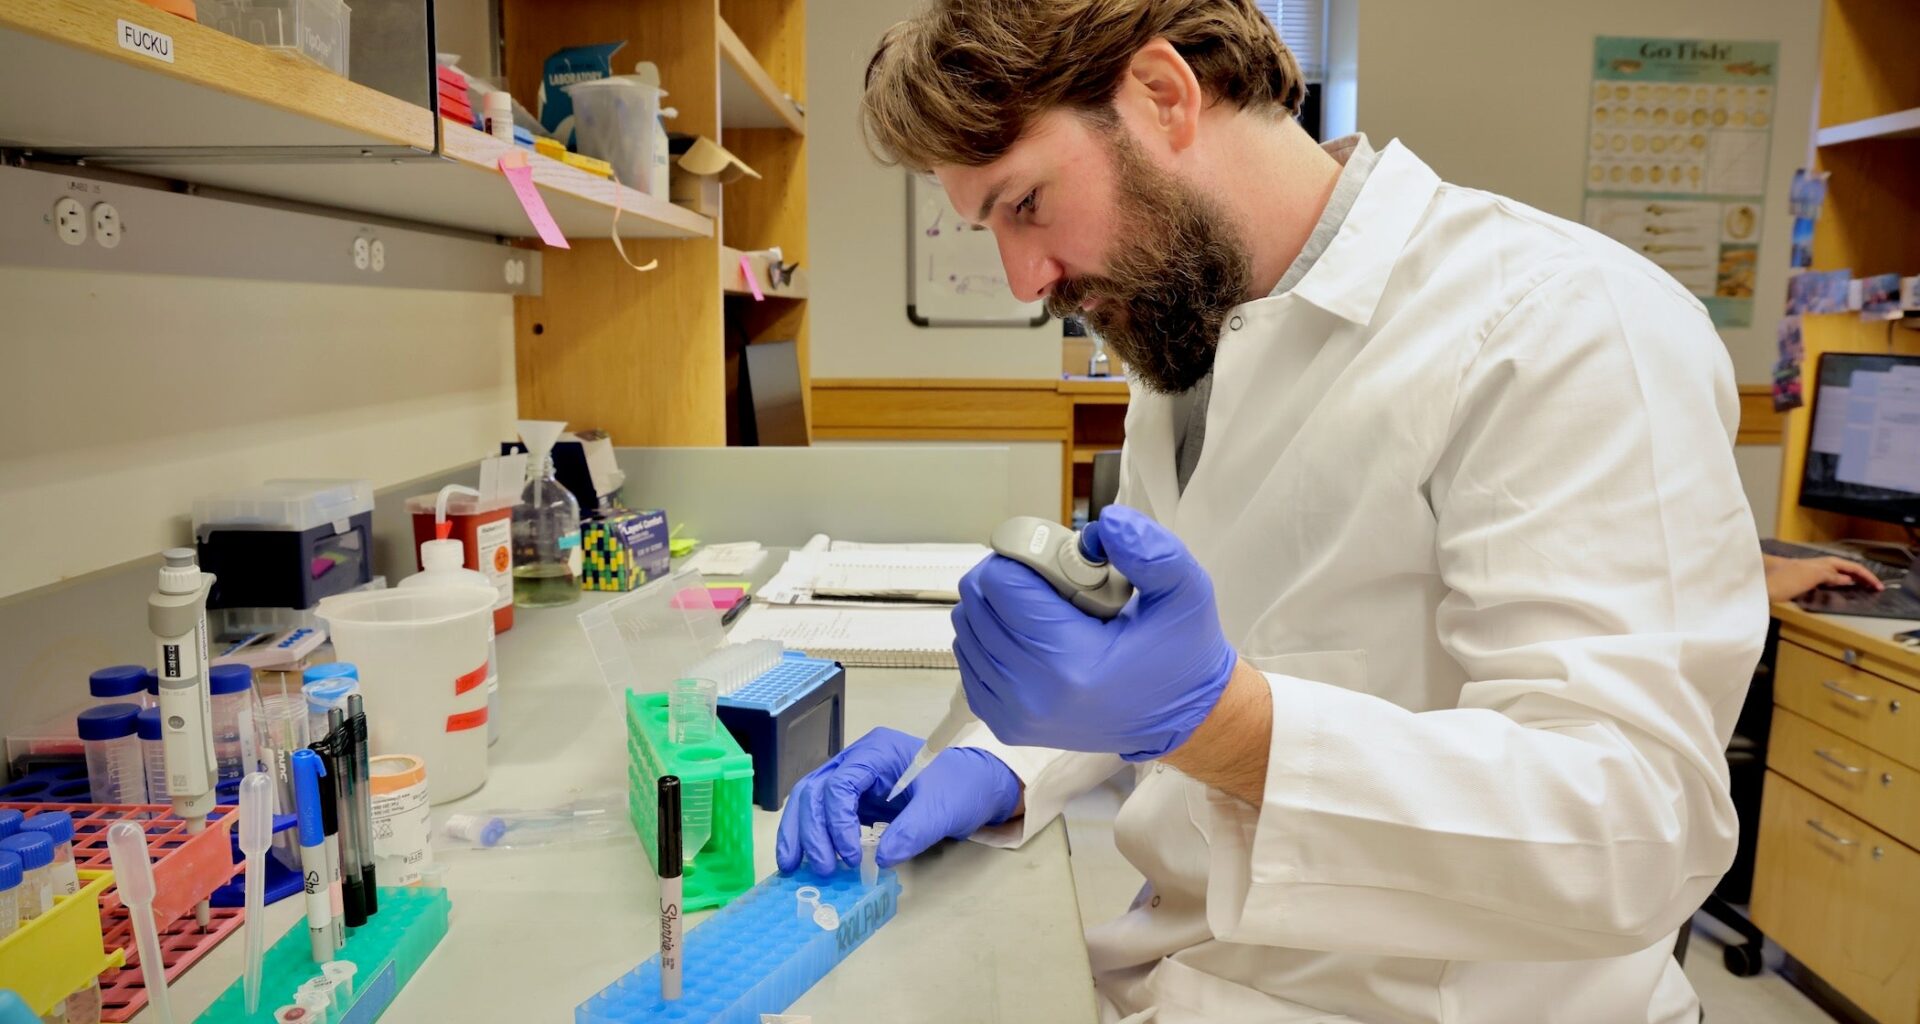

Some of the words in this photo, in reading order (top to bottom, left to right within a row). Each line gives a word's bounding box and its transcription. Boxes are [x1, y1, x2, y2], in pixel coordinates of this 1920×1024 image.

[124, 25, 168, 56] FUCKU
[1639, 42, 1672, 60] Go
[184, 800, 194, 808] 10
[659, 897, 678, 954] Sharpie
